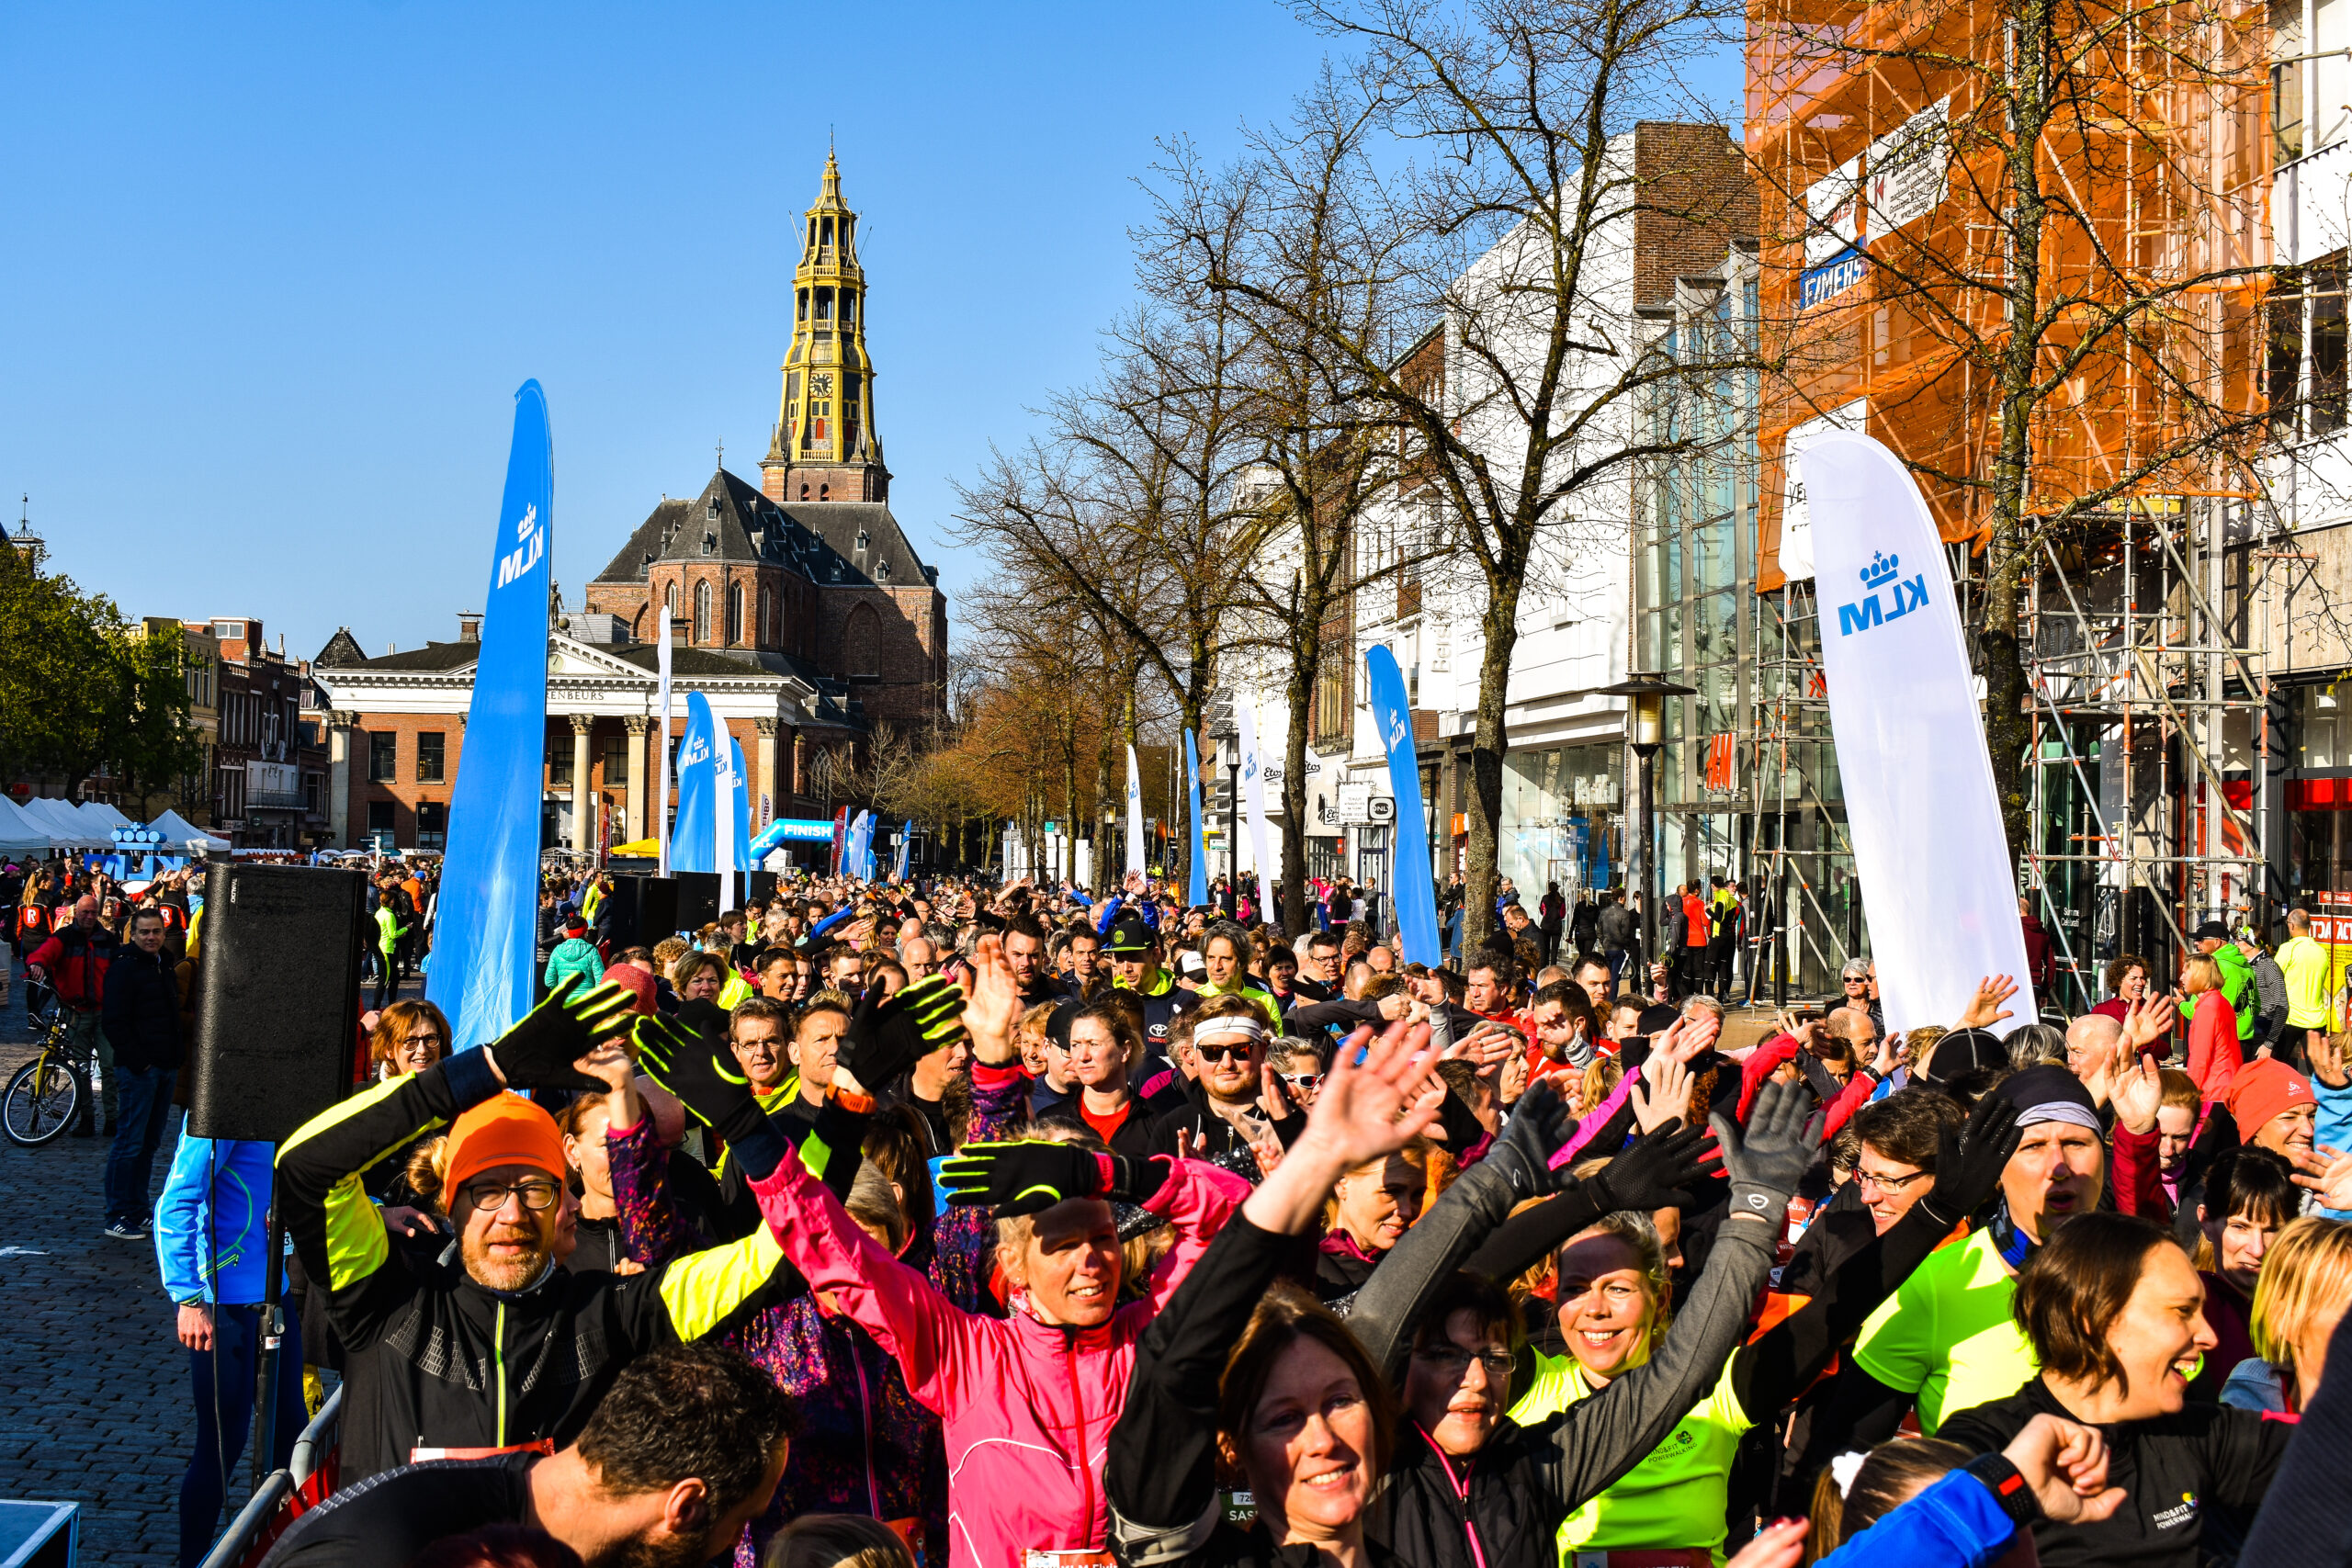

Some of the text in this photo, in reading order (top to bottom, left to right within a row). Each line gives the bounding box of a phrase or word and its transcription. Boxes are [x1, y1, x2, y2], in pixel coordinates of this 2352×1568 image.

[1263, 766, 1283, 781] Etos
[762, 798, 770, 828] EHBO
[784, 824, 831, 838] FINISH
[27, 908, 37, 923] R
[1648, 1442, 1698, 1463] POWERWALKING
[1228, 1510, 1259, 1521] SAS
[2153, 1504, 2188, 1522] MIND&FIT
